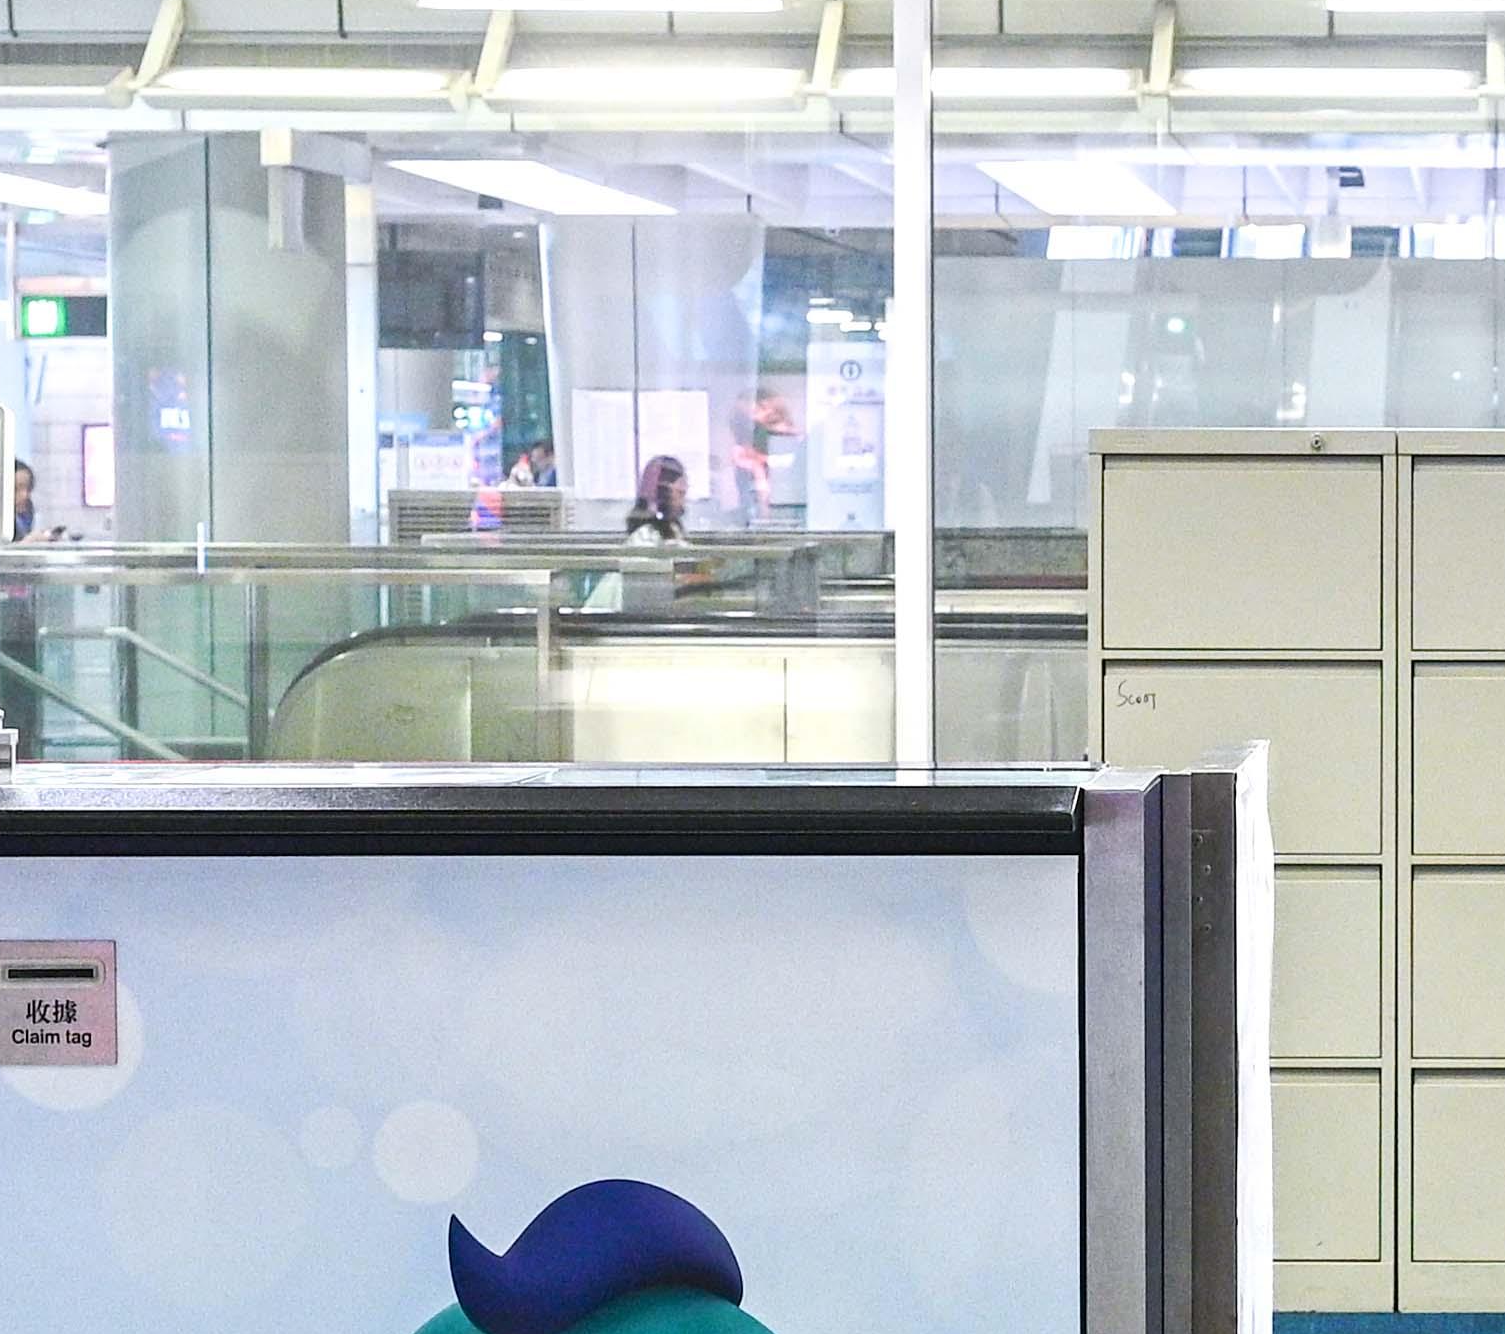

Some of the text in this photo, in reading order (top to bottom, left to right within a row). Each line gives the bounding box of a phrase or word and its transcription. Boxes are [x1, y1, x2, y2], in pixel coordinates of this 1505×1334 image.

[25, 999, 77, 1025] 收據
[11, 1028, 92, 1048] Claim tag
